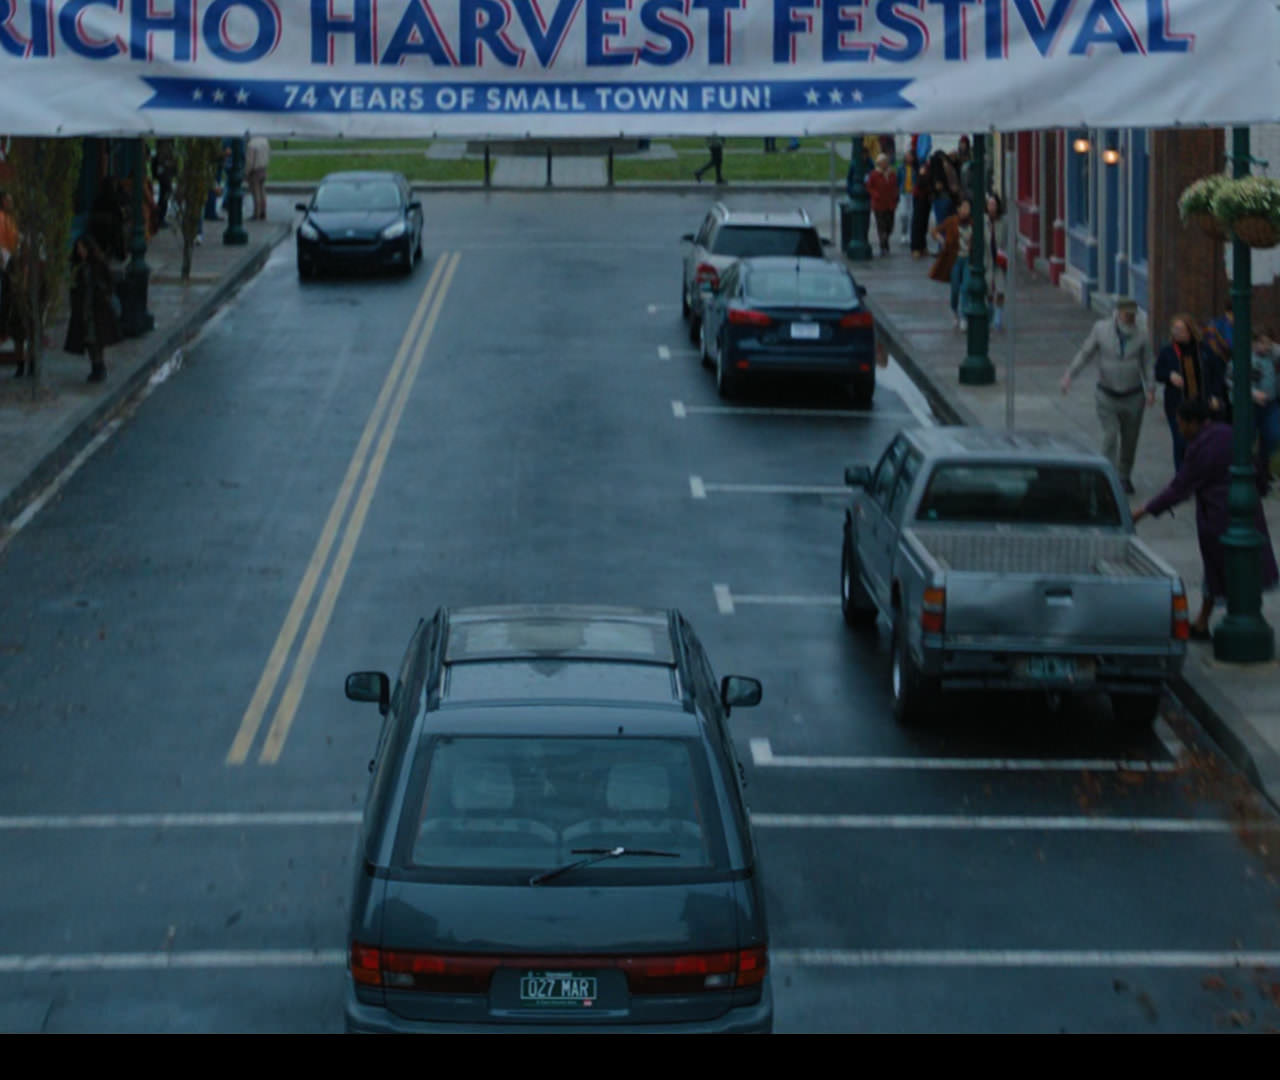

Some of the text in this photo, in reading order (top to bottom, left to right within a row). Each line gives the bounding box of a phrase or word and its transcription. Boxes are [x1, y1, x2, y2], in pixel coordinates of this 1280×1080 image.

[283, 85, 772, 111] 74 YEARS OF SMALL TOWN FUN!
[561, 978, 589, 998] MAR
